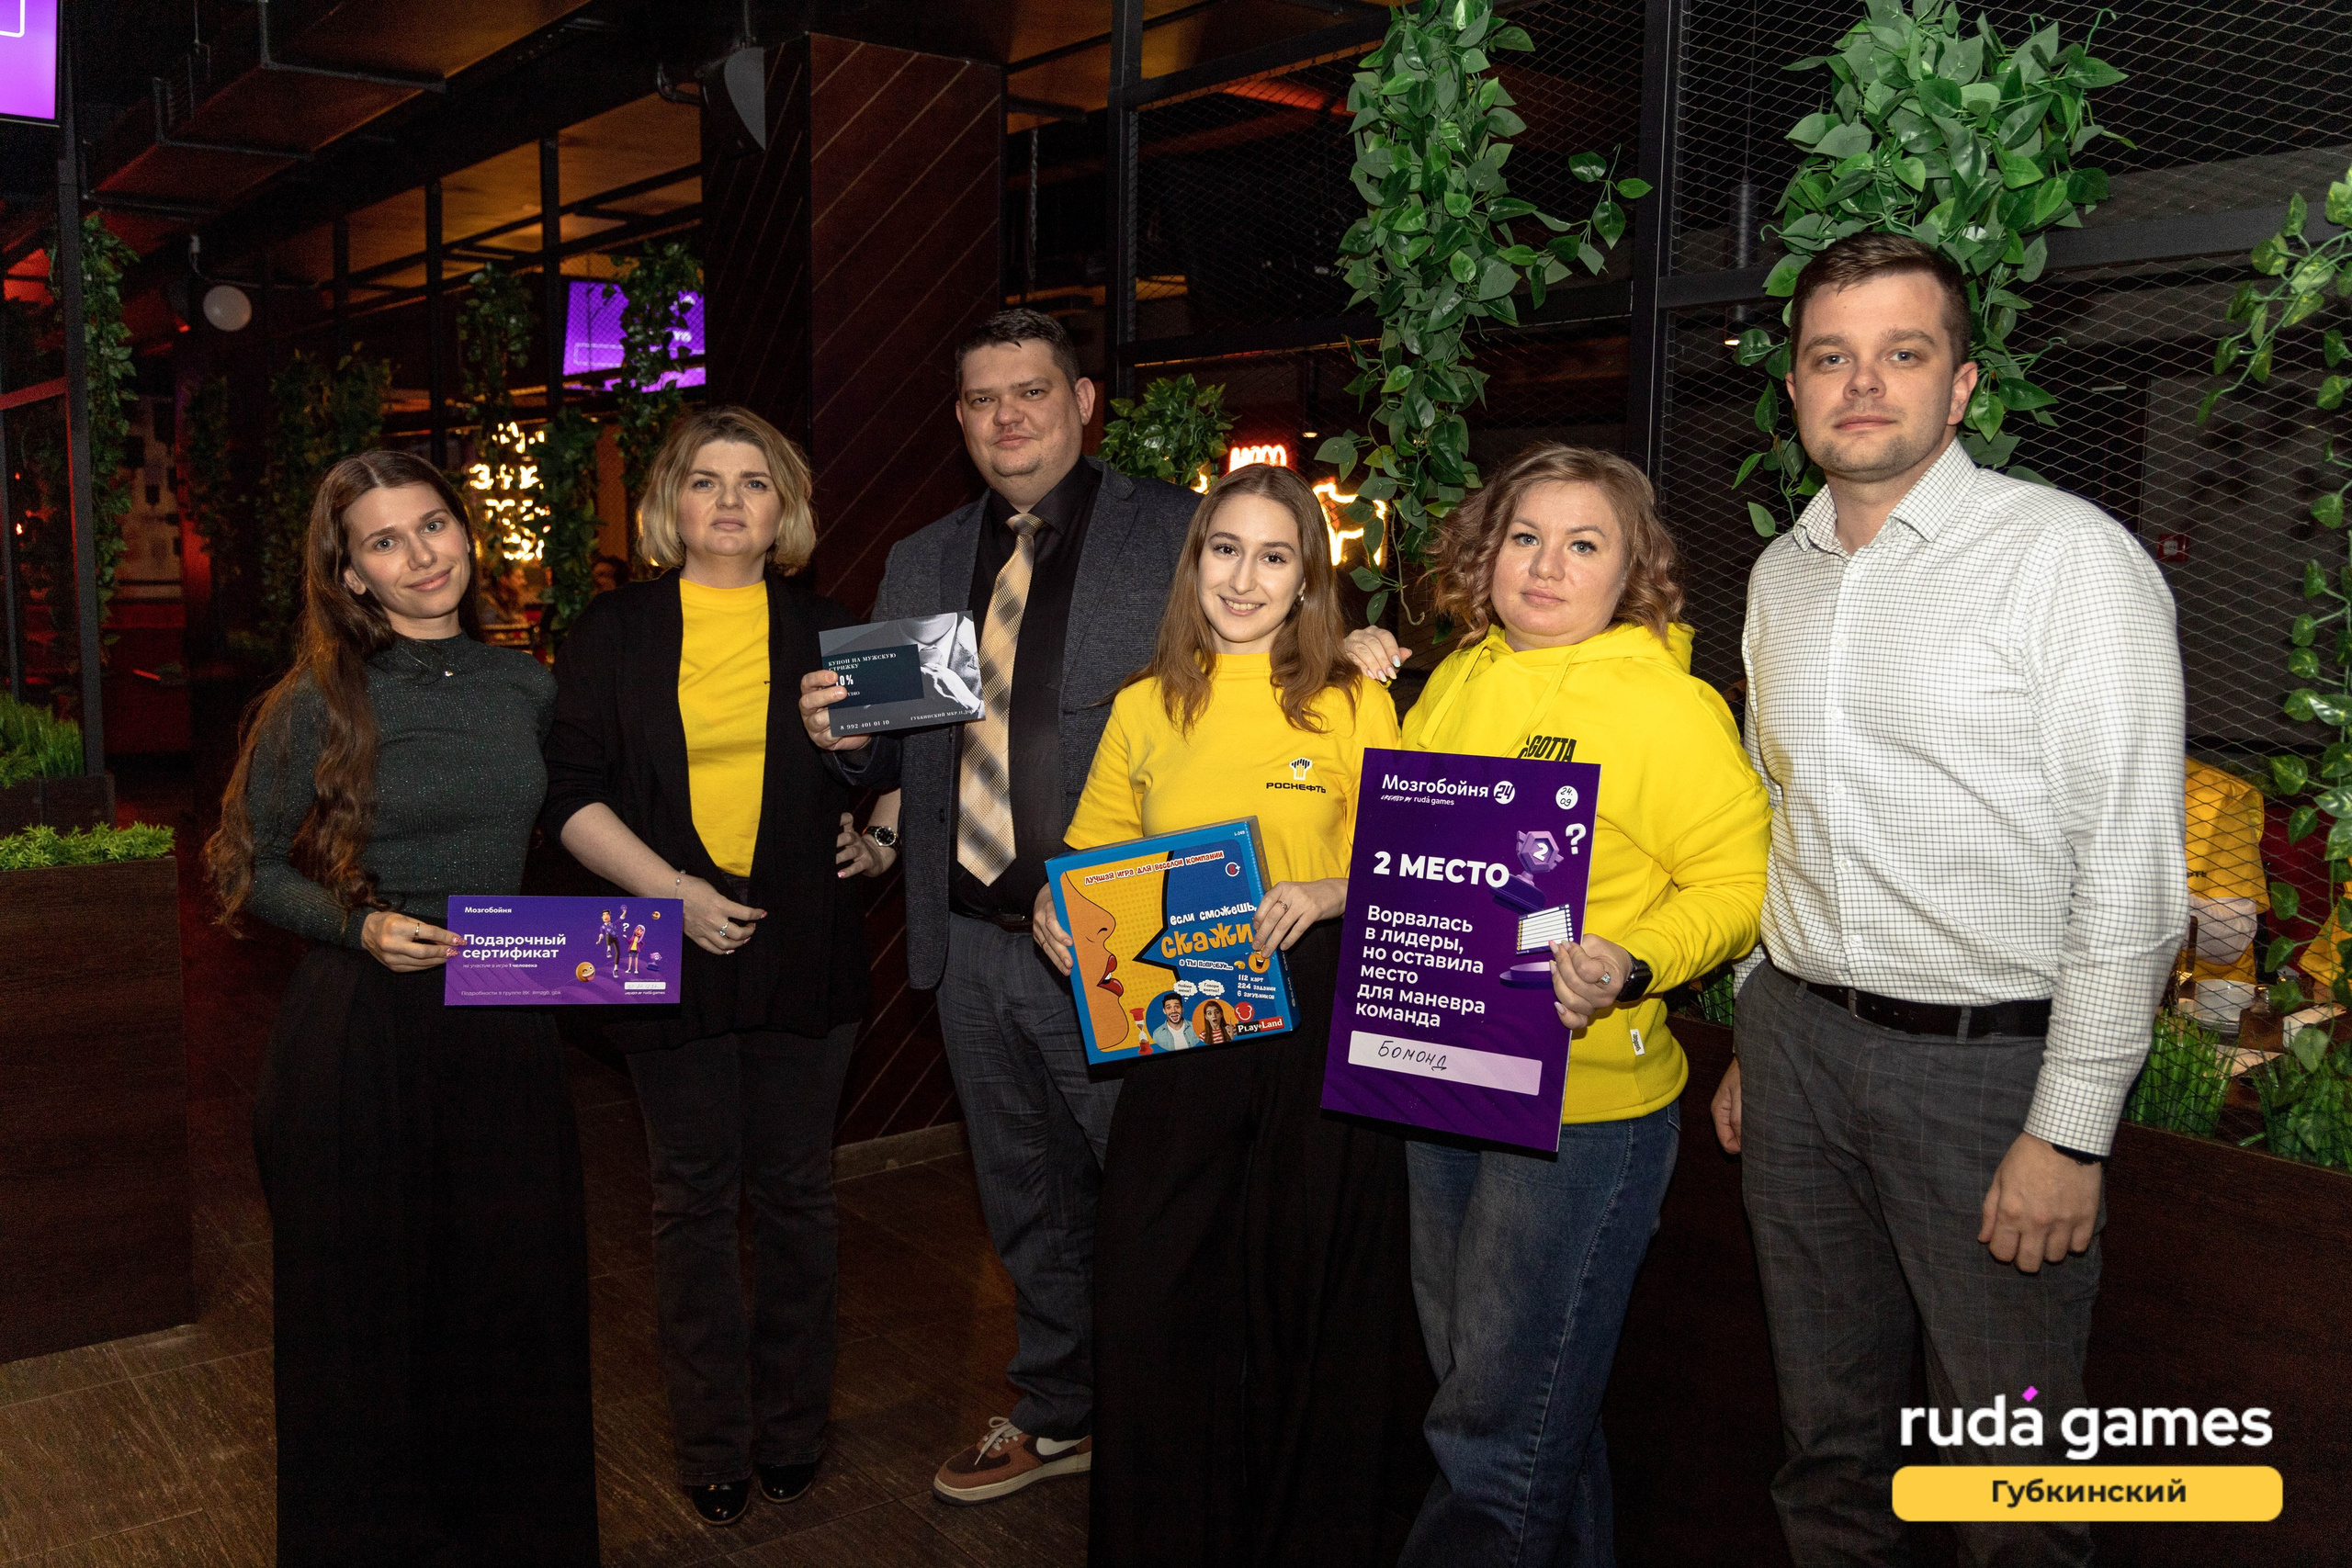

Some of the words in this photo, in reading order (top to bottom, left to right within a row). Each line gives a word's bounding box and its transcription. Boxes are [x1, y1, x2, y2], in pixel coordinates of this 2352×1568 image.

[863, 653, 896, 661] МУЖСКУЮ
[1529, 735, 1577, 761] GOTTA
[1266, 783, 1326, 793] РОСНЕФТЬ
[1382, 774, 1489, 797] Мозгобойня
[1533, 842, 1548, 861] 2
[1373, 851, 1392, 875] 2
[1399, 853, 1510, 888] МЕСТО
[1367, 905, 1473, 932] Ворвалась
[464, 933, 566, 947] Подарочный
[1365, 927, 1375, 940] в
[1380, 930, 1464, 953] лидеры,
[462, 947, 559, 960] сертификат
[1363, 946, 1386, 960] но
[1392, 950, 1484, 974] оставила
[1361, 965, 1419, 984] место
[1357, 984, 1394, 1000] для
[1399, 989, 1486, 1015] маневра
[1355, 1003, 1441, 1028] команда
